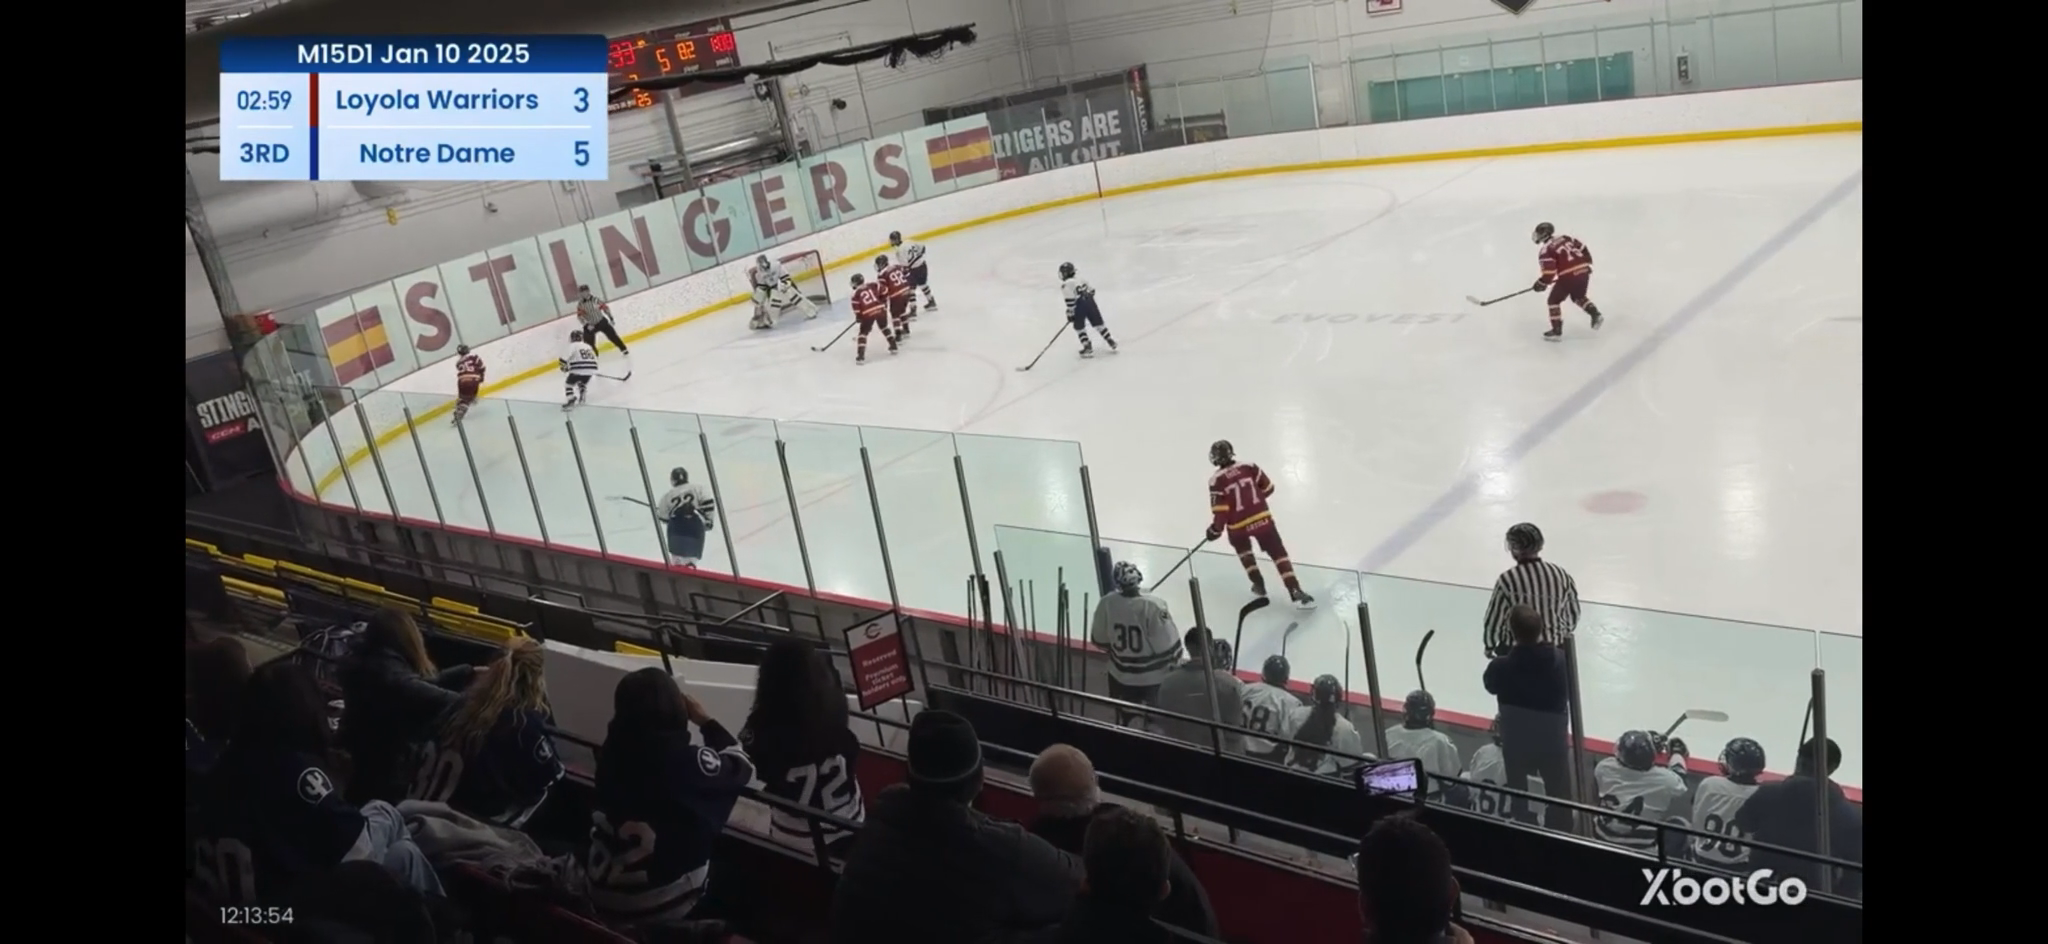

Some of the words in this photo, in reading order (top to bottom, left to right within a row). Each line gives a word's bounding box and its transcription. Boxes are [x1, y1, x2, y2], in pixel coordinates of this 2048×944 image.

[677, 41, 696, 60] 82
[1081, 109, 1122, 141] ARE
[404, 142, 911, 352] STINGERS
[860, 289, 878, 305] 21
[1225, 476, 1261, 512] 77
[1113, 623, 1143, 654] 30
[861, 649, 897, 667] Reserved
[865, 663, 899, 682] Premium
[786, 753, 850, 808] 72
